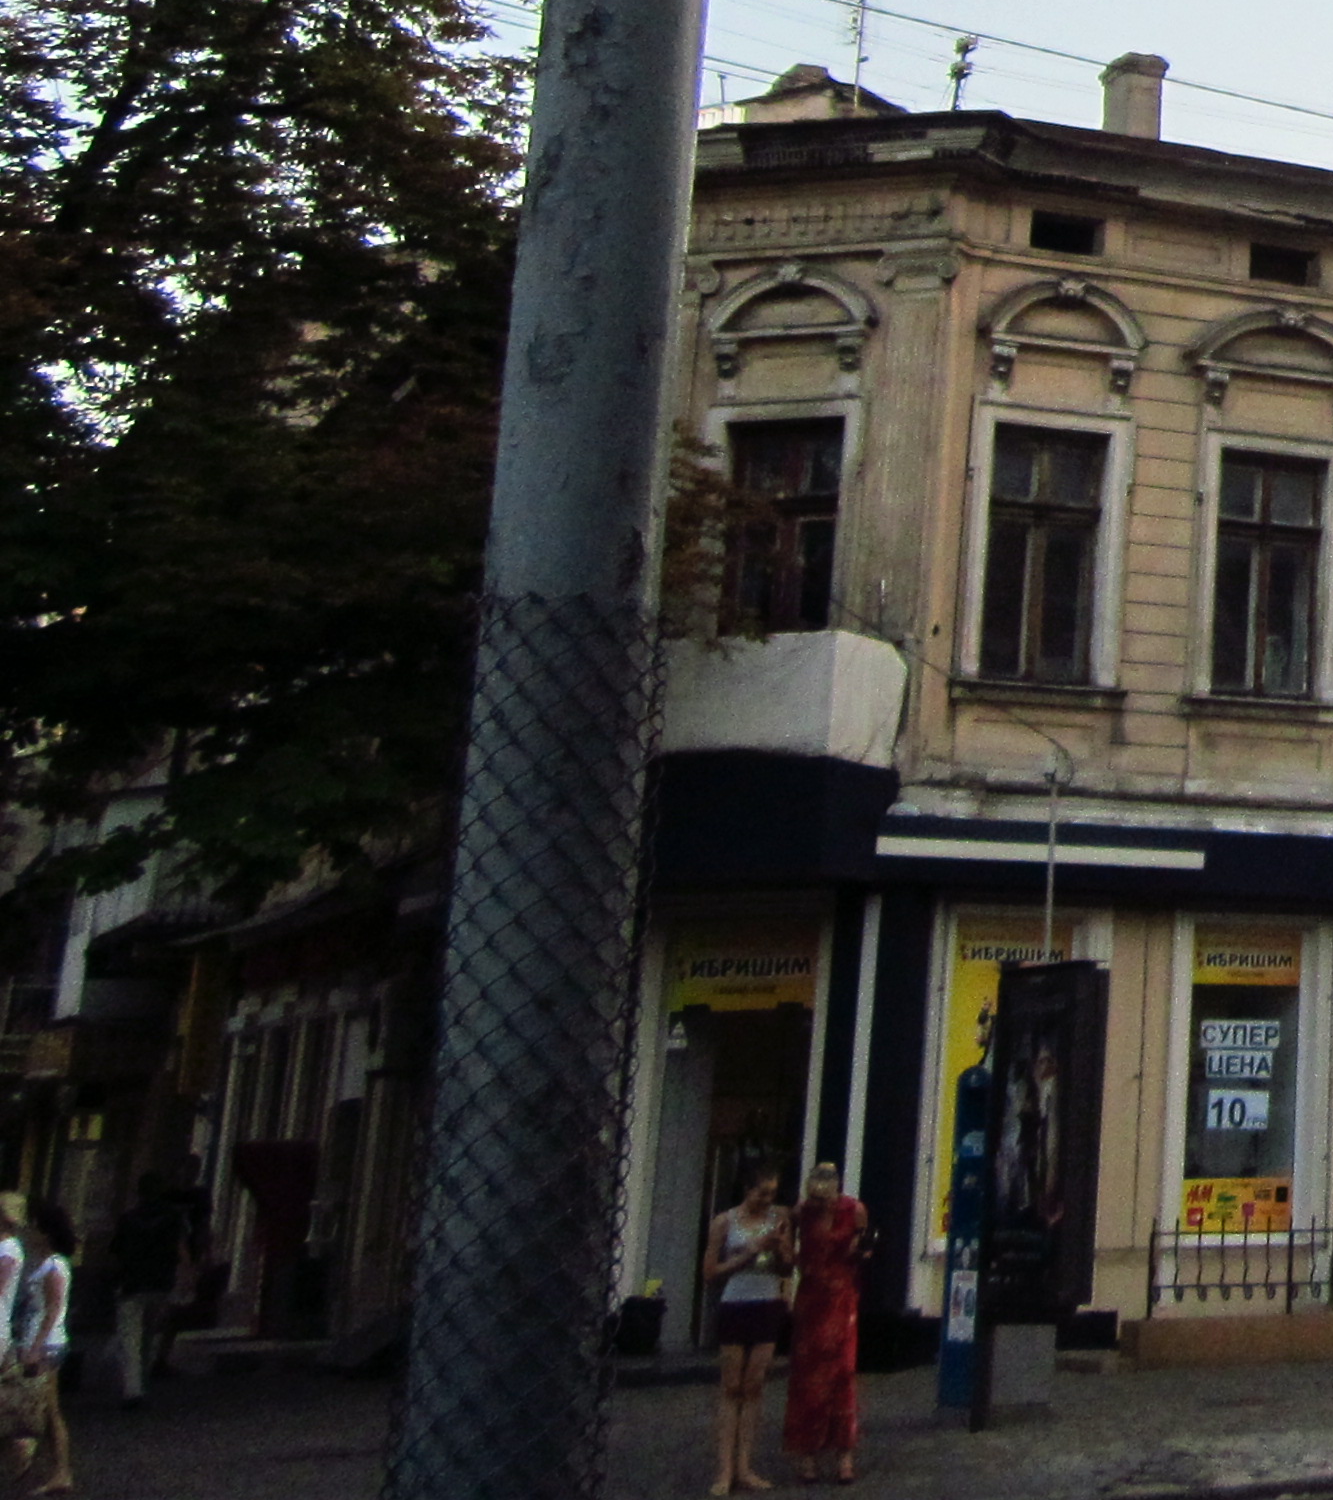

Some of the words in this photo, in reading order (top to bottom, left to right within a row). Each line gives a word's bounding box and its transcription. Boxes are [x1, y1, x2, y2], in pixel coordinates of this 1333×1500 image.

[689, 957, 812, 978] ИБРИШИМ
[1205, 952, 1293, 969] ИБРИШИМ
[1202, 1024, 1279, 1046] СУПЕР
[1207, 1055, 1271, 1076] ЦЕНА
[1210, 1097, 1247, 1128] 10
